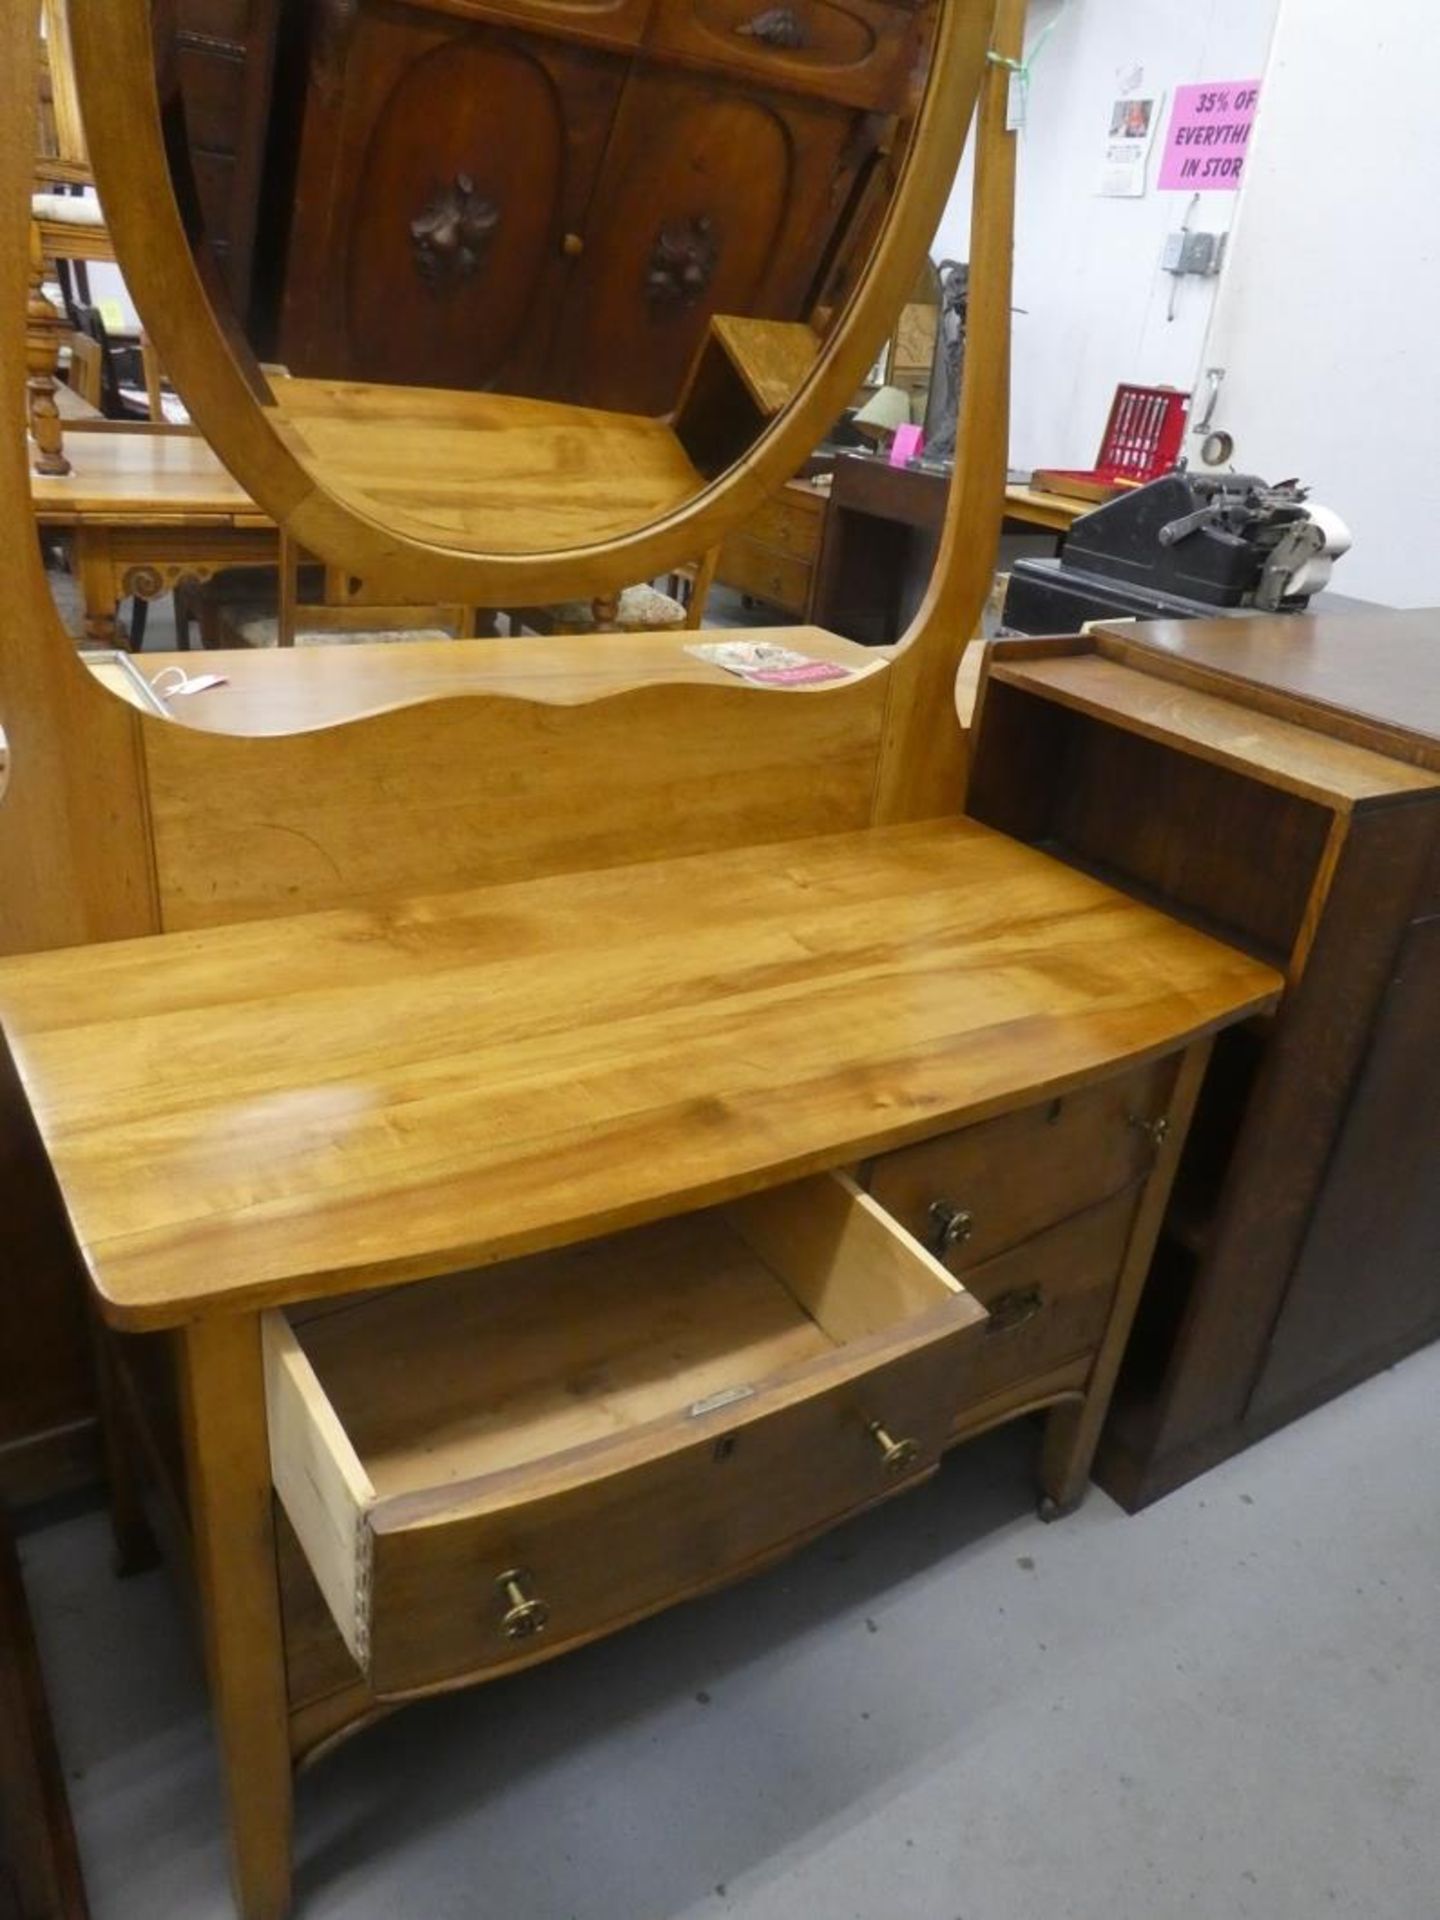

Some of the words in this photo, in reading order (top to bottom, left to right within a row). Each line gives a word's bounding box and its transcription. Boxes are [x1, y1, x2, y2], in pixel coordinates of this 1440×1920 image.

[1195, 92, 1229, 112] 35%
[1234, 90, 1257, 110] OF
[1175, 124, 1251, 145] EVERYTHI
[1180, 158, 1200, 177] IN
[1202, 157, 1243, 178] STOR
